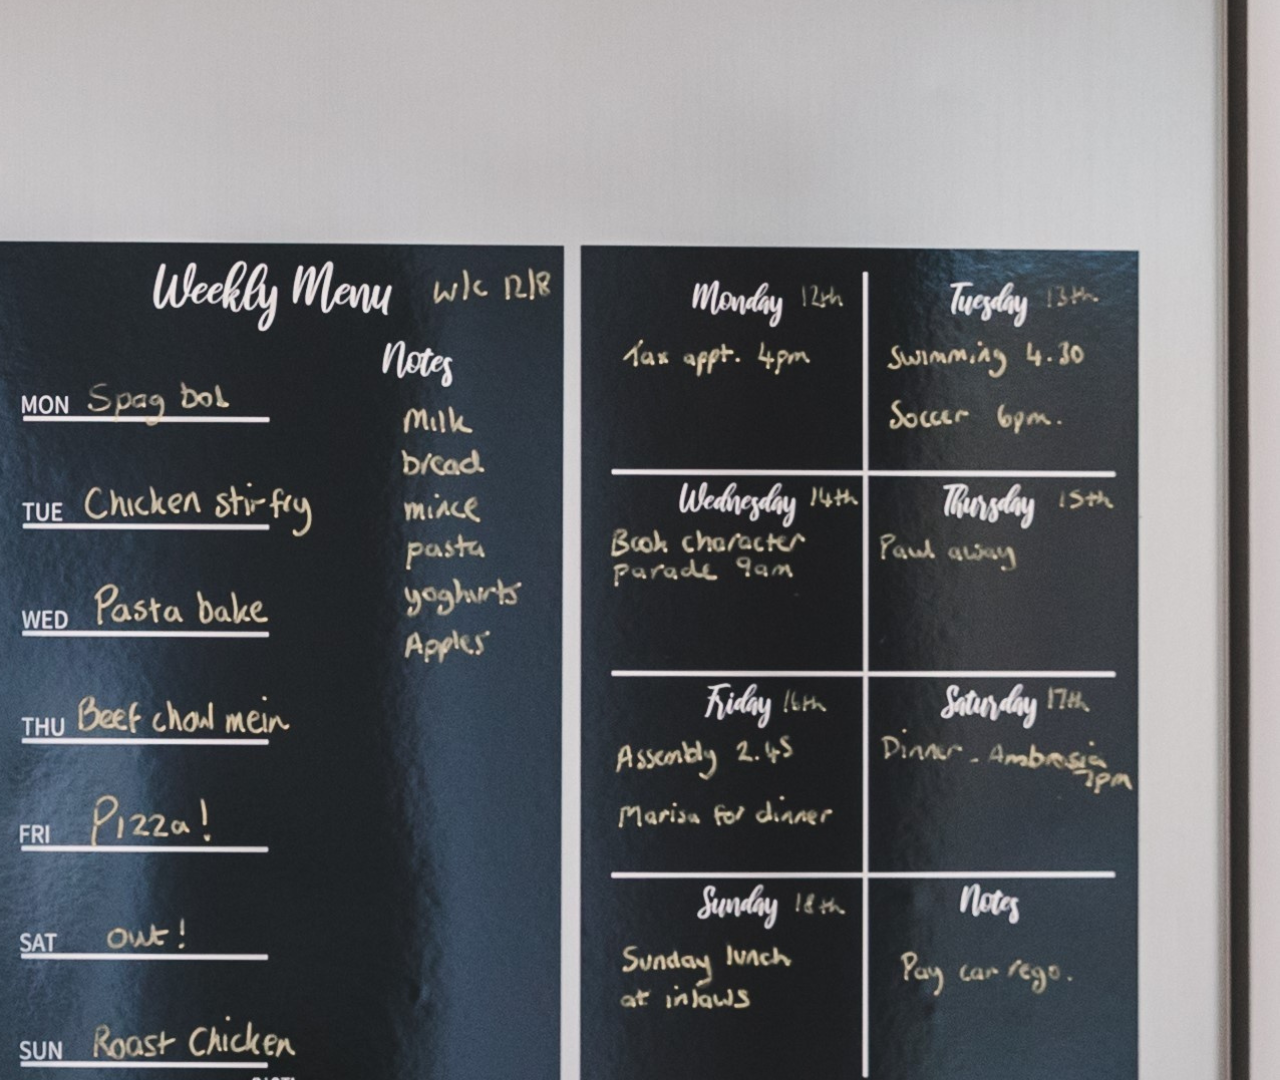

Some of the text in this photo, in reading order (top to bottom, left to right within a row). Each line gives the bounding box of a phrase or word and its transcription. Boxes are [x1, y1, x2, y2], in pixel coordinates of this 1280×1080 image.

[152, 260, 393, 332] Weekly Menu
[692, 280, 783, 328] Monday
[950, 281, 1029, 328] Tuesday
[382, 340, 454, 387] Notes
[623, 339, 669, 368] Tax
[757, 342, 811, 375] 4pm
[887, 340, 1008, 379] Swimming
[21, 395, 69, 415] MON
[87, 382, 165, 425] Spag
[889, 399, 970, 429] Soccer
[402, 449, 485, 476] bread
[21, 502, 63, 523] TUE
[84, 486, 201, 519] Chicken
[404, 493, 481, 523] mince
[678, 481, 797, 528] Wednesday
[810, 486, 859, 508] 14th
[943, 483, 1035, 529] Thursday
[1058, 490, 1115, 510] 15th
[406, 534, 485, 570] pasta
[611, 528, 806, 557] Book character
[880, 533, 1017, 572] Paul away
[736, 556, 794, 578] 9am
[95, 584, 268, 626] Pasta bake
[404, 578, 522, 616] yoghurts
[21, 610, 68, 630] WED
[404, 630, 490, 663] Apples
[77, 696, 291, 734] Beef chow mein
[704, 683, 772, 729] Friday
[940, 683, 1038, 730] Saturday
[1047, 685, 1091, 712] 17th
[21, 717, 65, 737] THU
[881, 728, 963, 761] Dinner
[615, 739, 718, 781] Assembly
[713, 803, 745, 826] for
[755, 795, 833, 826] dinner
[19, 825, 50, 844] FRI
[697, 884, 779, 930] Sunday
[959, 883, 1020, 925] Notes
[19, 933, 57, 952] SAT
[621, 944, 792, 987] Sunday lunch
[900, 951, 944, 996] Pay
[959, 963, 999, 982] car
[620, 989, 651, 1009] at
[19, 1041, 63, 1060] SUN
[93, 1015, 296, 1061] Roast Chicken
